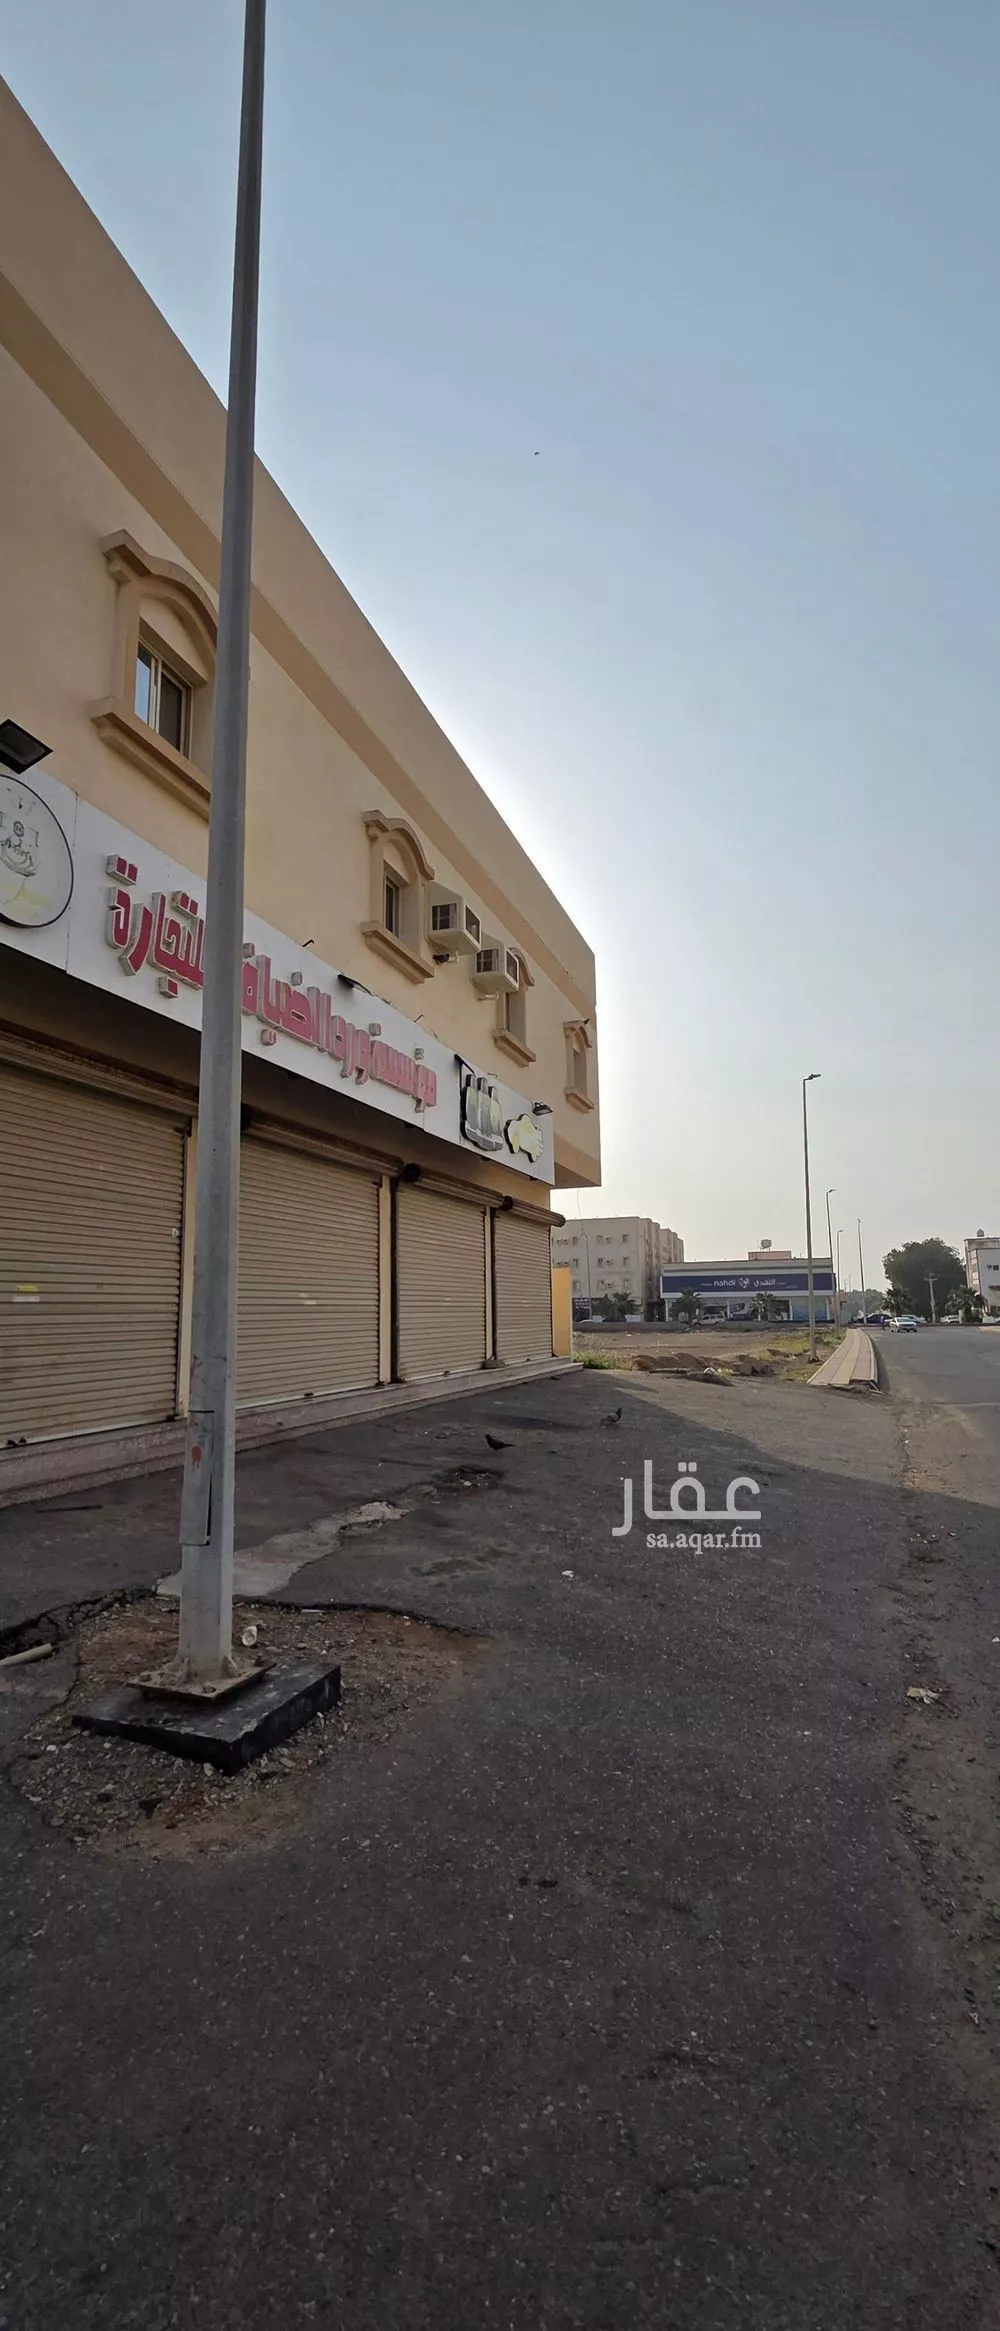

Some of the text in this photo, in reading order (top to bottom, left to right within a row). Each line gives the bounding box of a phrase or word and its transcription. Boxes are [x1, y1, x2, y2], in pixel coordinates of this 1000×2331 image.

[106, 854, 205, 998] لتجارة
[242, 942, 332, 1053] الضياف
[713, 1279, 736, 1287] nahdi
